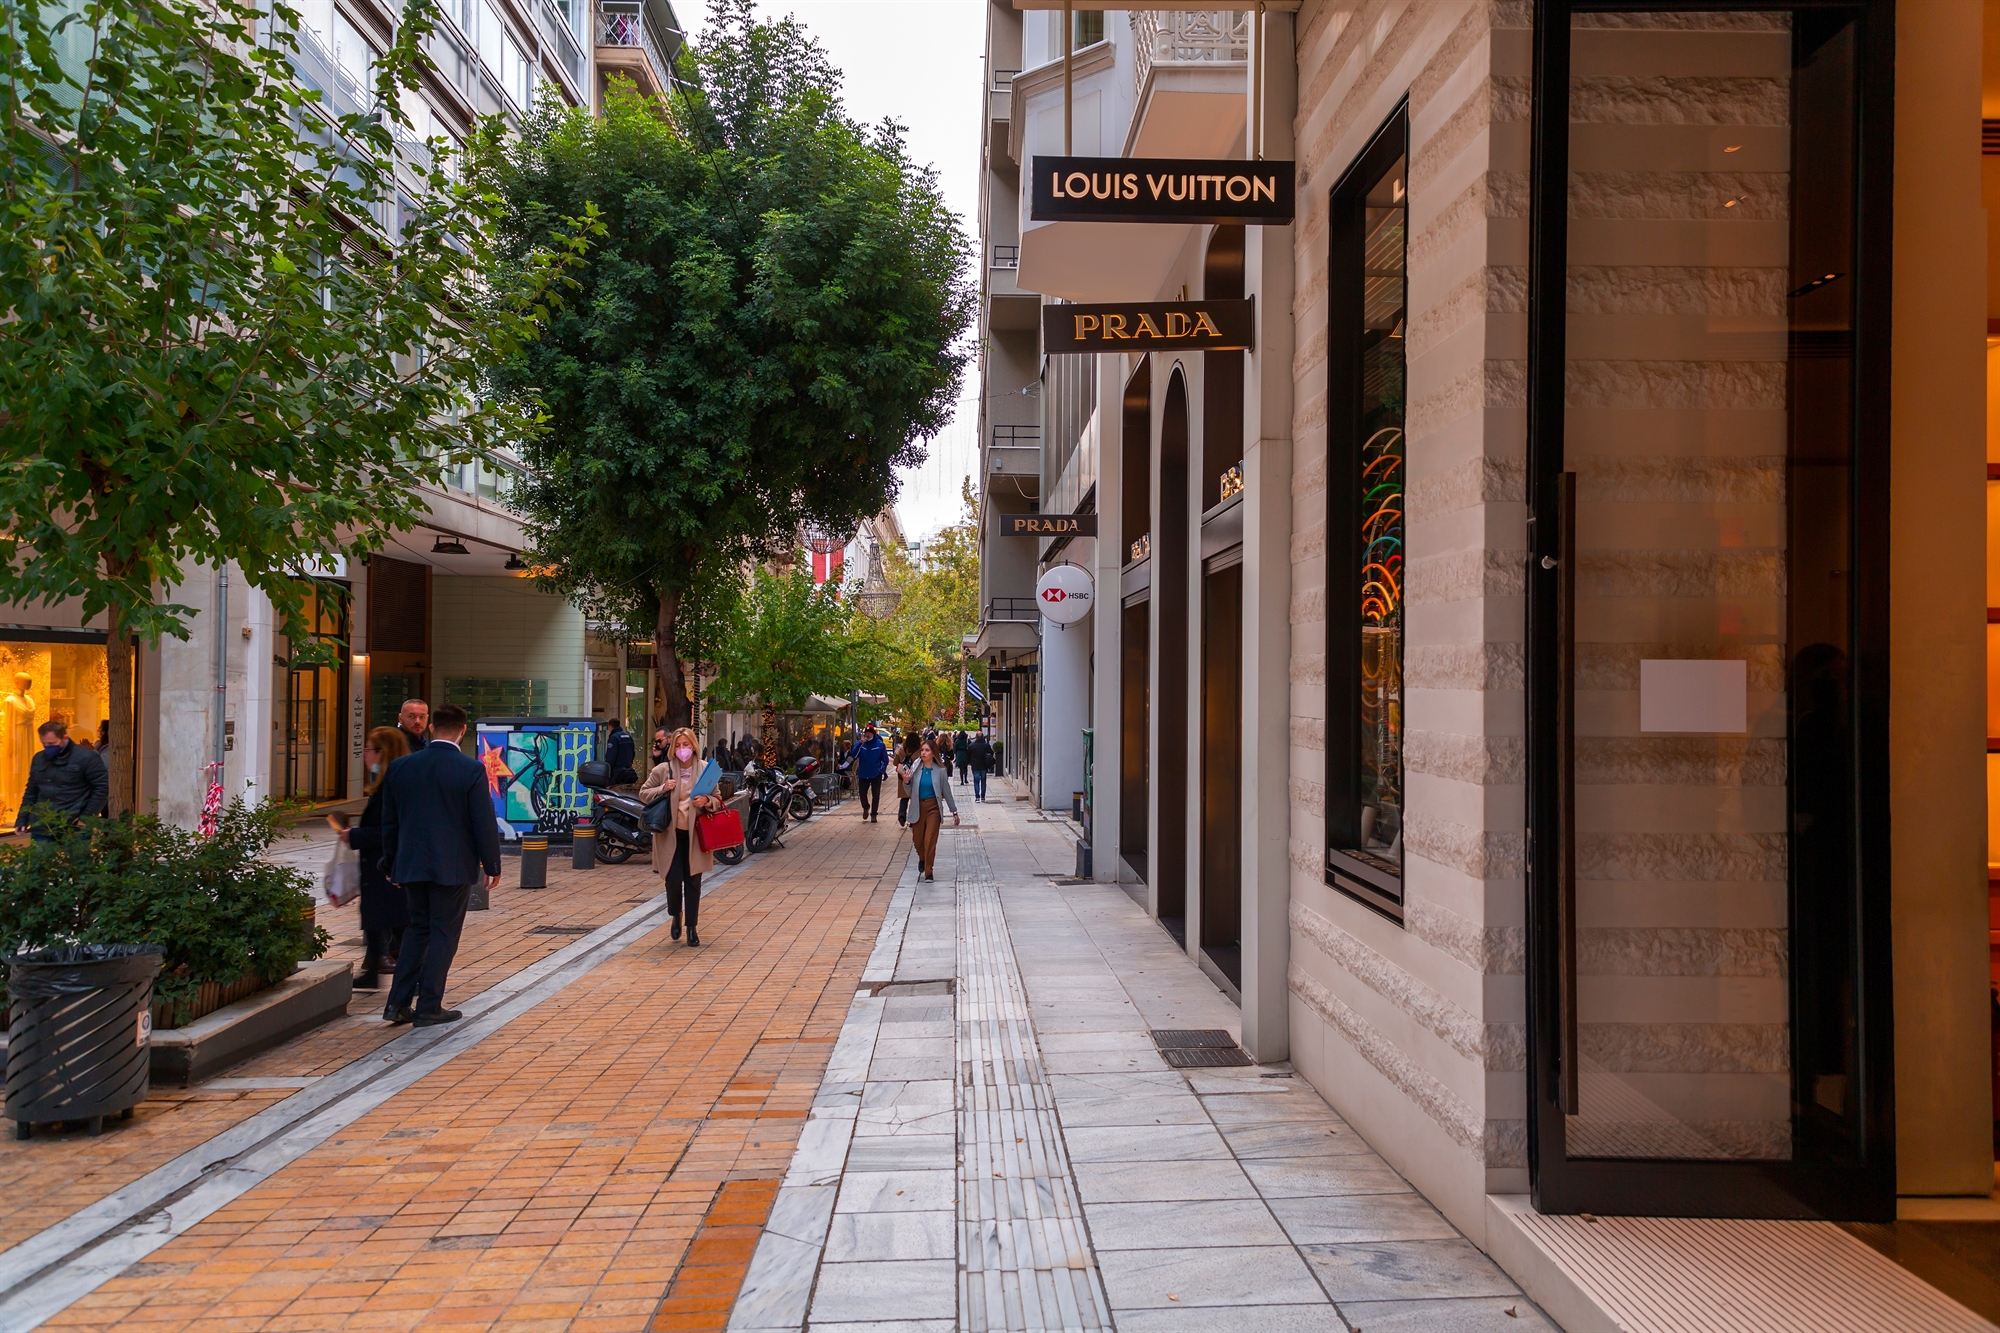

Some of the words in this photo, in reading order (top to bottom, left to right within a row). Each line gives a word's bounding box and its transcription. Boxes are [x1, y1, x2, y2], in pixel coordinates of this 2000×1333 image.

[1052, 171, 1139, 200] LOUIS
[1146, 173, 1276, 203] VUITTON
[1074, 311, 1222, 341] PRADA
[1014, 519, 1083, 532] PRADA
[1068, 592, 1089, 600] HSBC
[445, 687, 451, 695] 6
